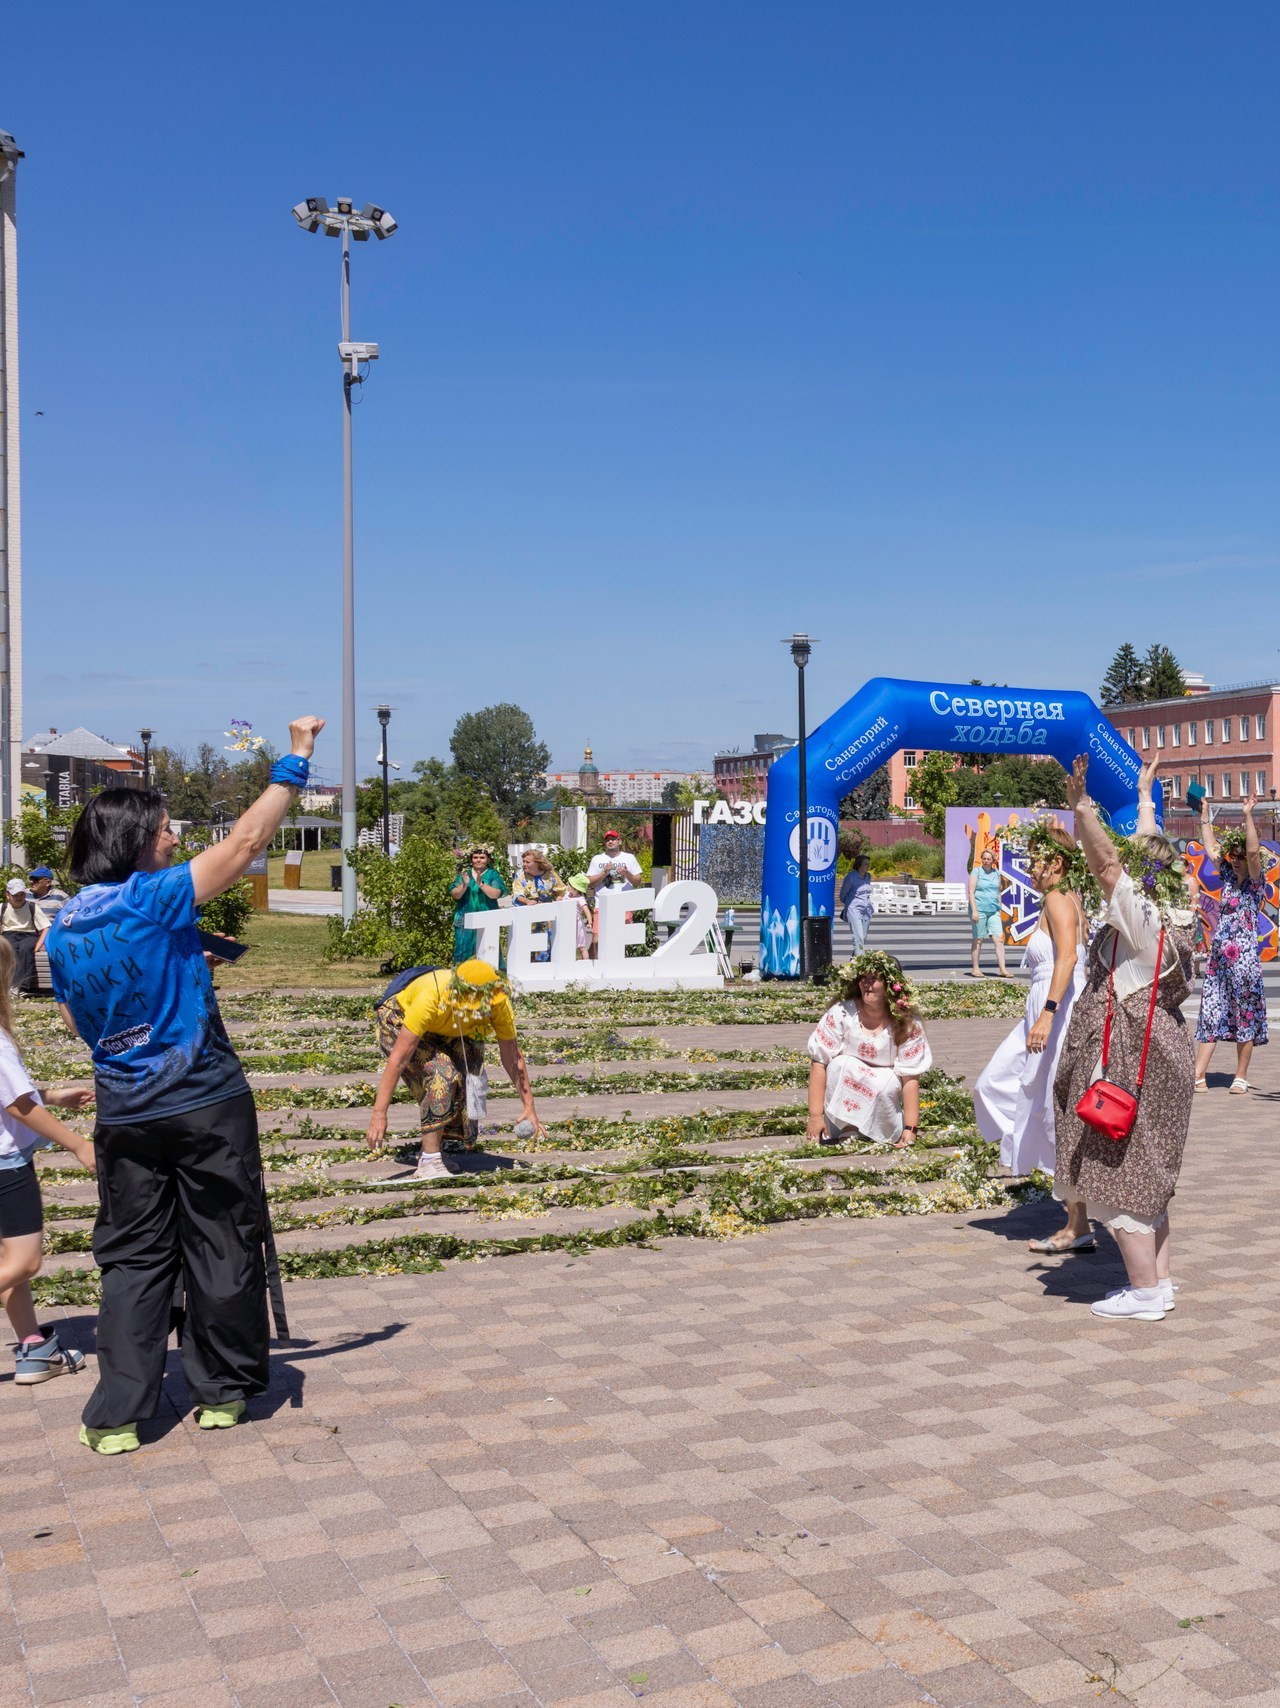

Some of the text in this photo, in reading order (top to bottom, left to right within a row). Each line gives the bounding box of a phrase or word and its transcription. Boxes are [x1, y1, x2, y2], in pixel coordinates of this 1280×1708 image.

[929, 690, 1065, 725] Северная
[825, 716, 888, 770] Санаторий
[950, 720, 1047, 746] ходьба
[59, 771, 70, 811] СТАВКА
[464, 880, 717, 980] TELE2
